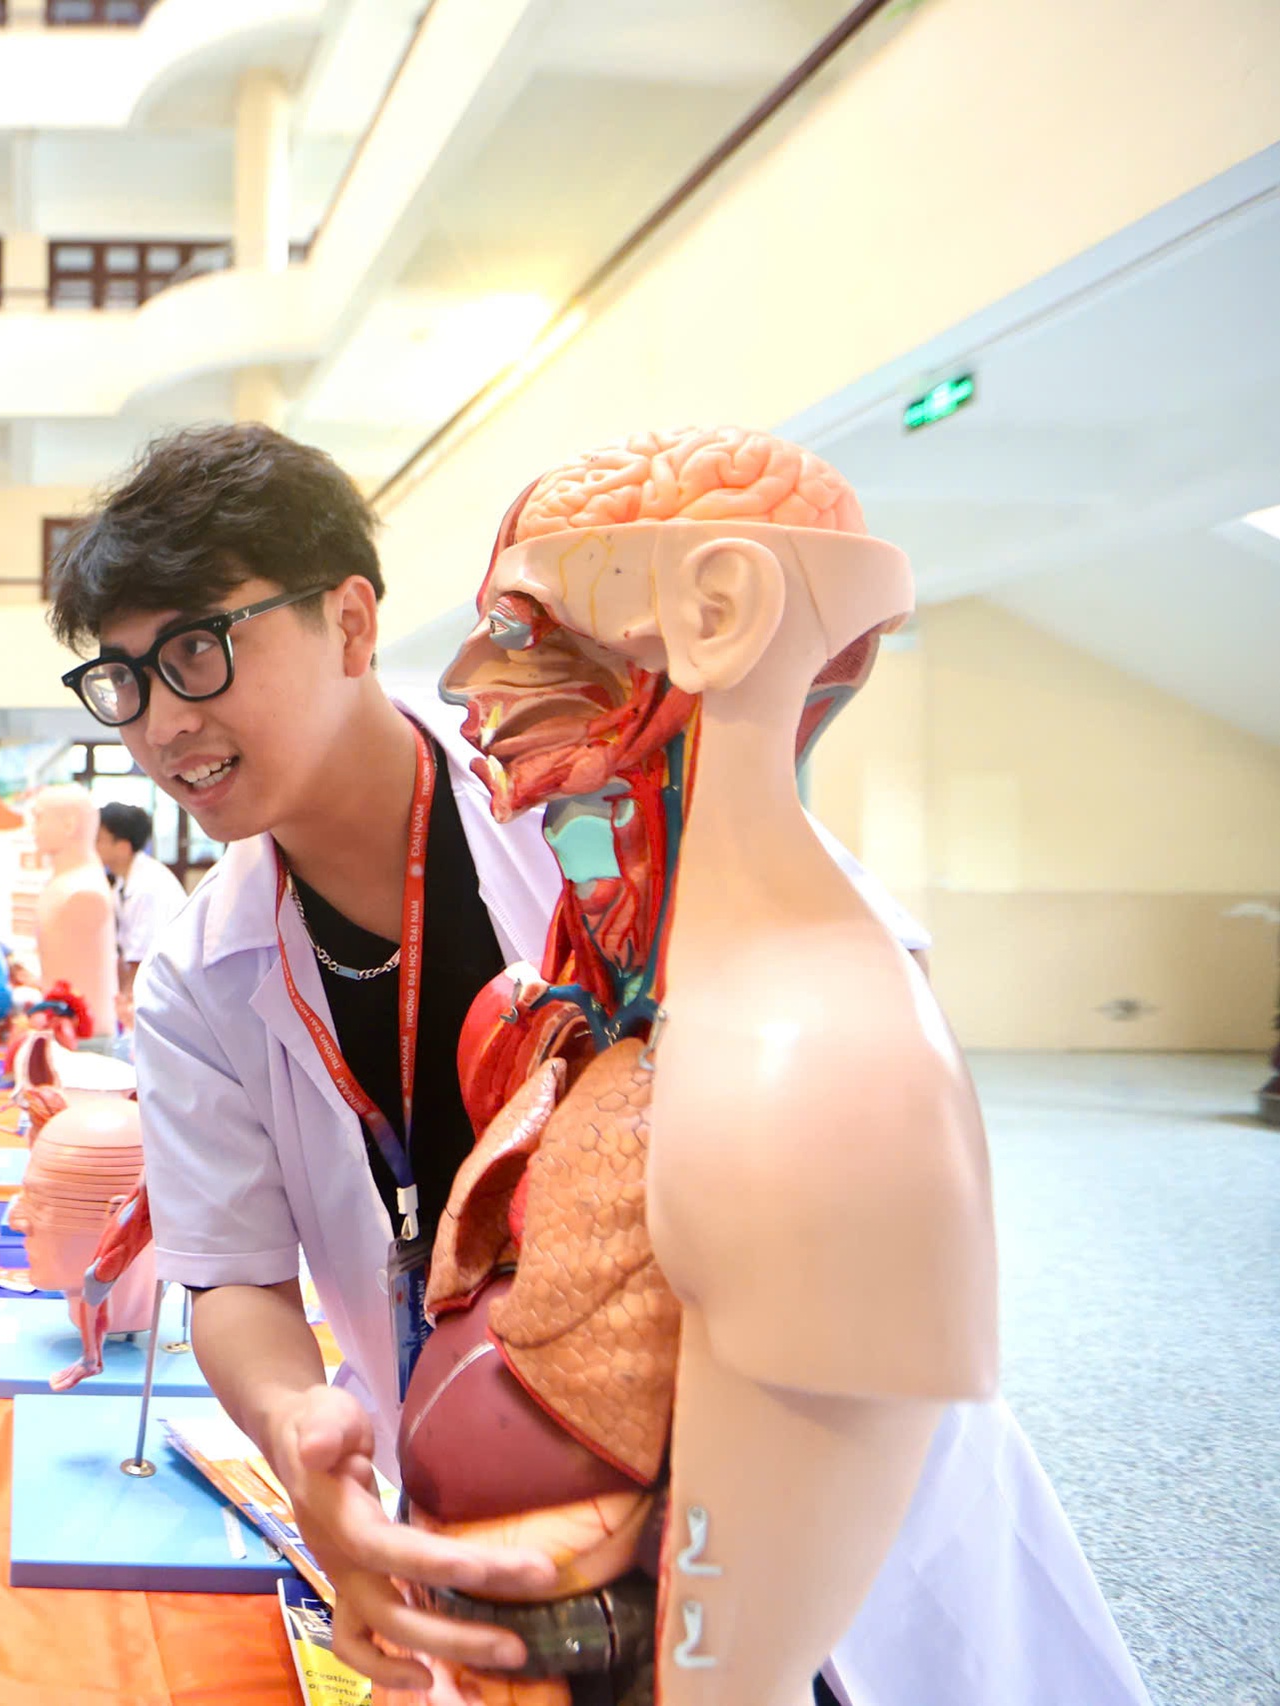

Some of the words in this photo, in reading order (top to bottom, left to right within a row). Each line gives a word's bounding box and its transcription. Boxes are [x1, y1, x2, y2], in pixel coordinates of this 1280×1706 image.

[413, 804, 425, 832] NAM
[410, 900, 420, 922] NAM
[336, 1077, 360, 1107] NAM
